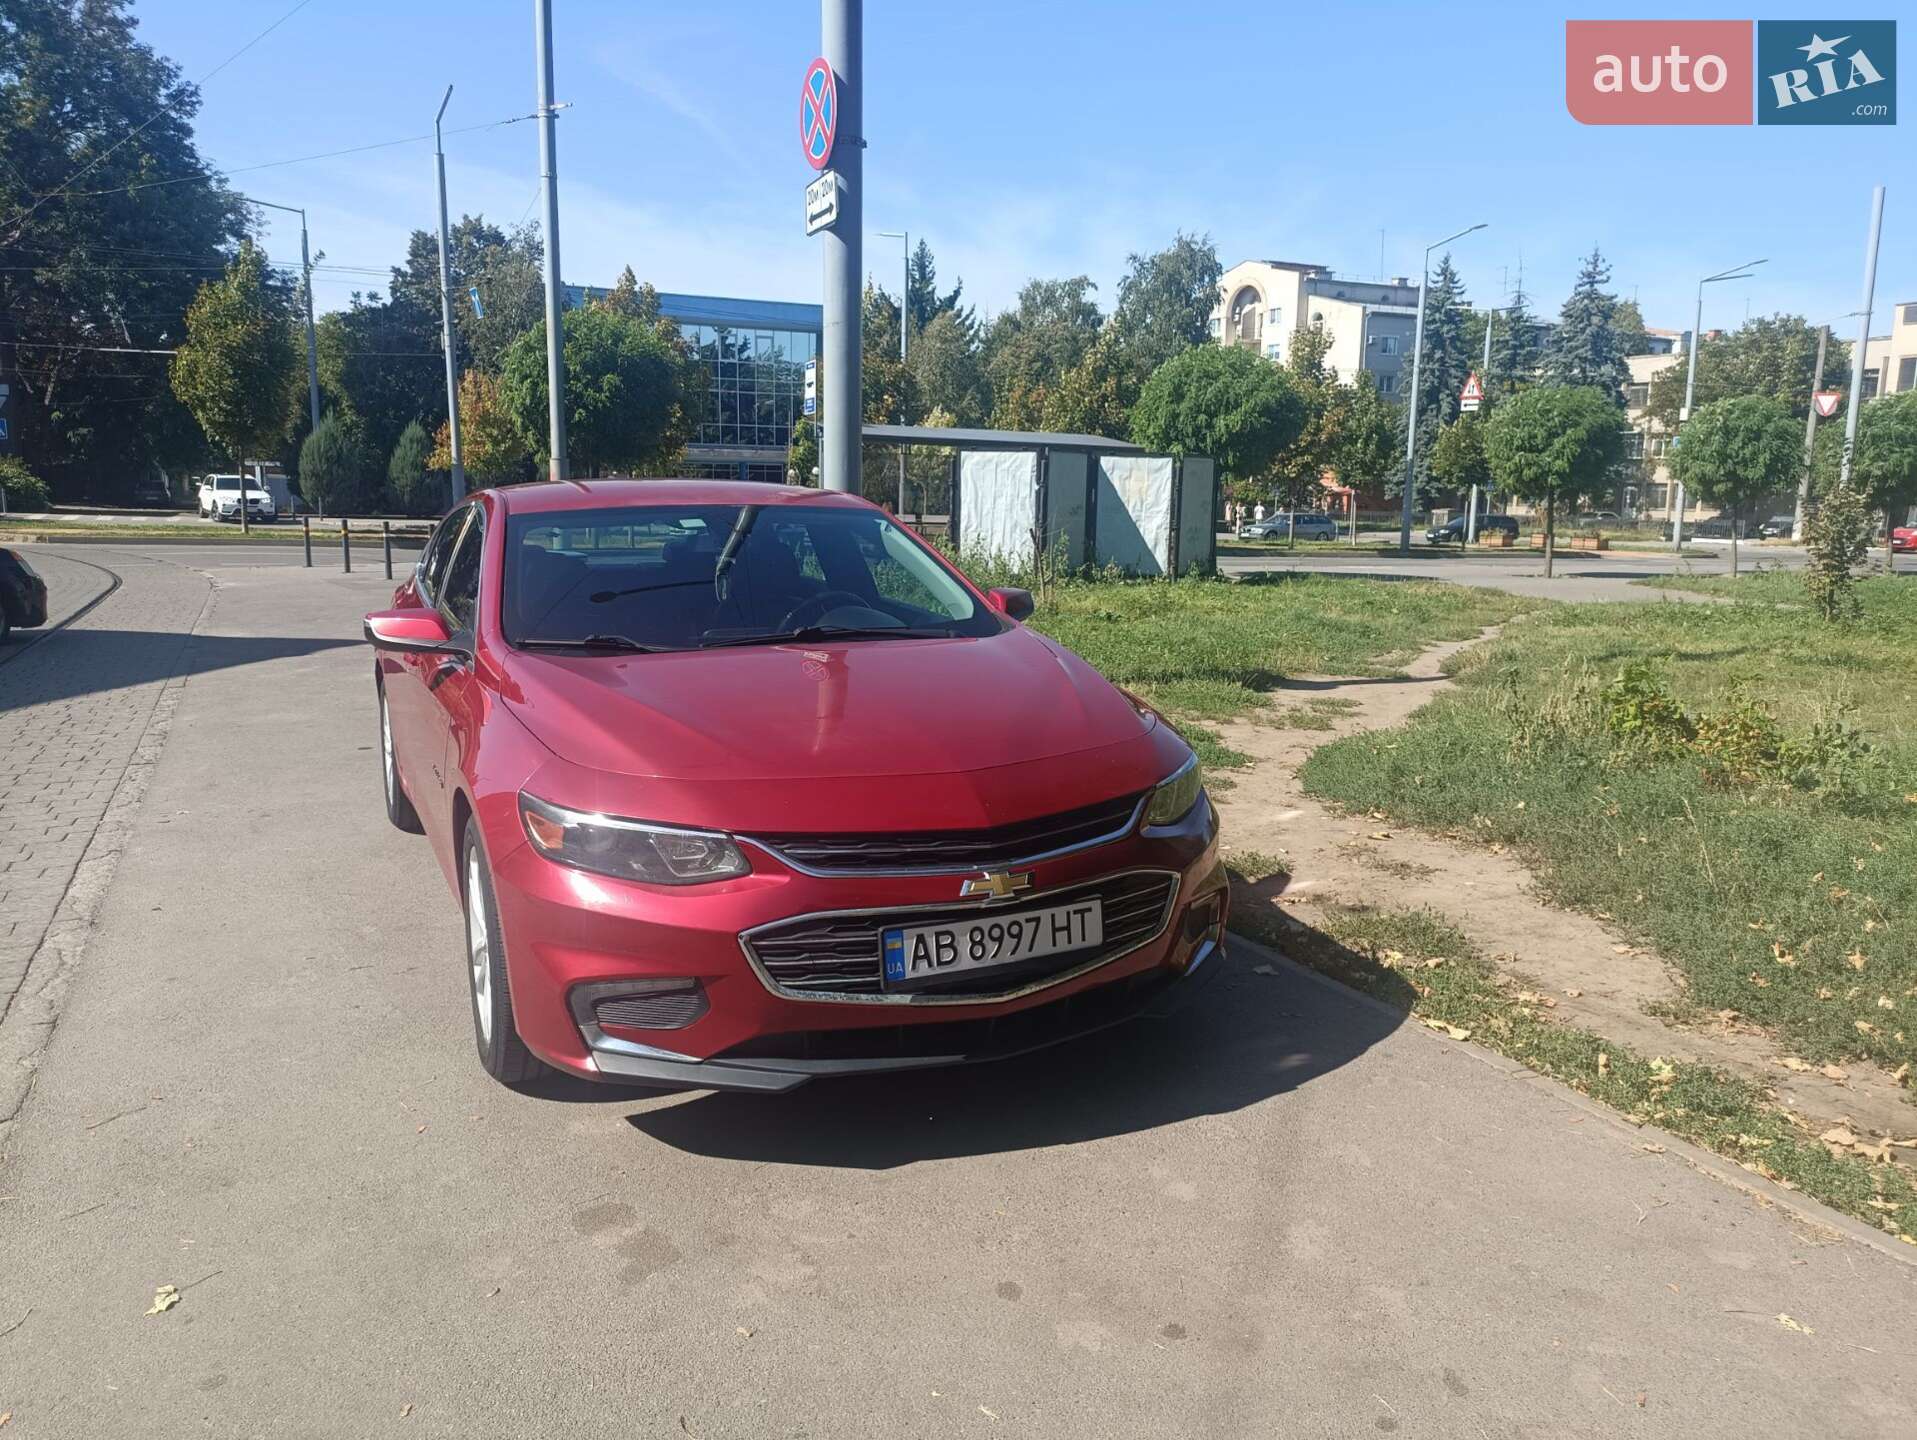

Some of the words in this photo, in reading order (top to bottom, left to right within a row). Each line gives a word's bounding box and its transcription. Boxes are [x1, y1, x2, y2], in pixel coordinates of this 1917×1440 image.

[910, 930, 958, 972] AB
[968, 916, 1042, 962] 8997
[1050, 907, 1093, 948] HT
[887, 961, 904, 975] UA
